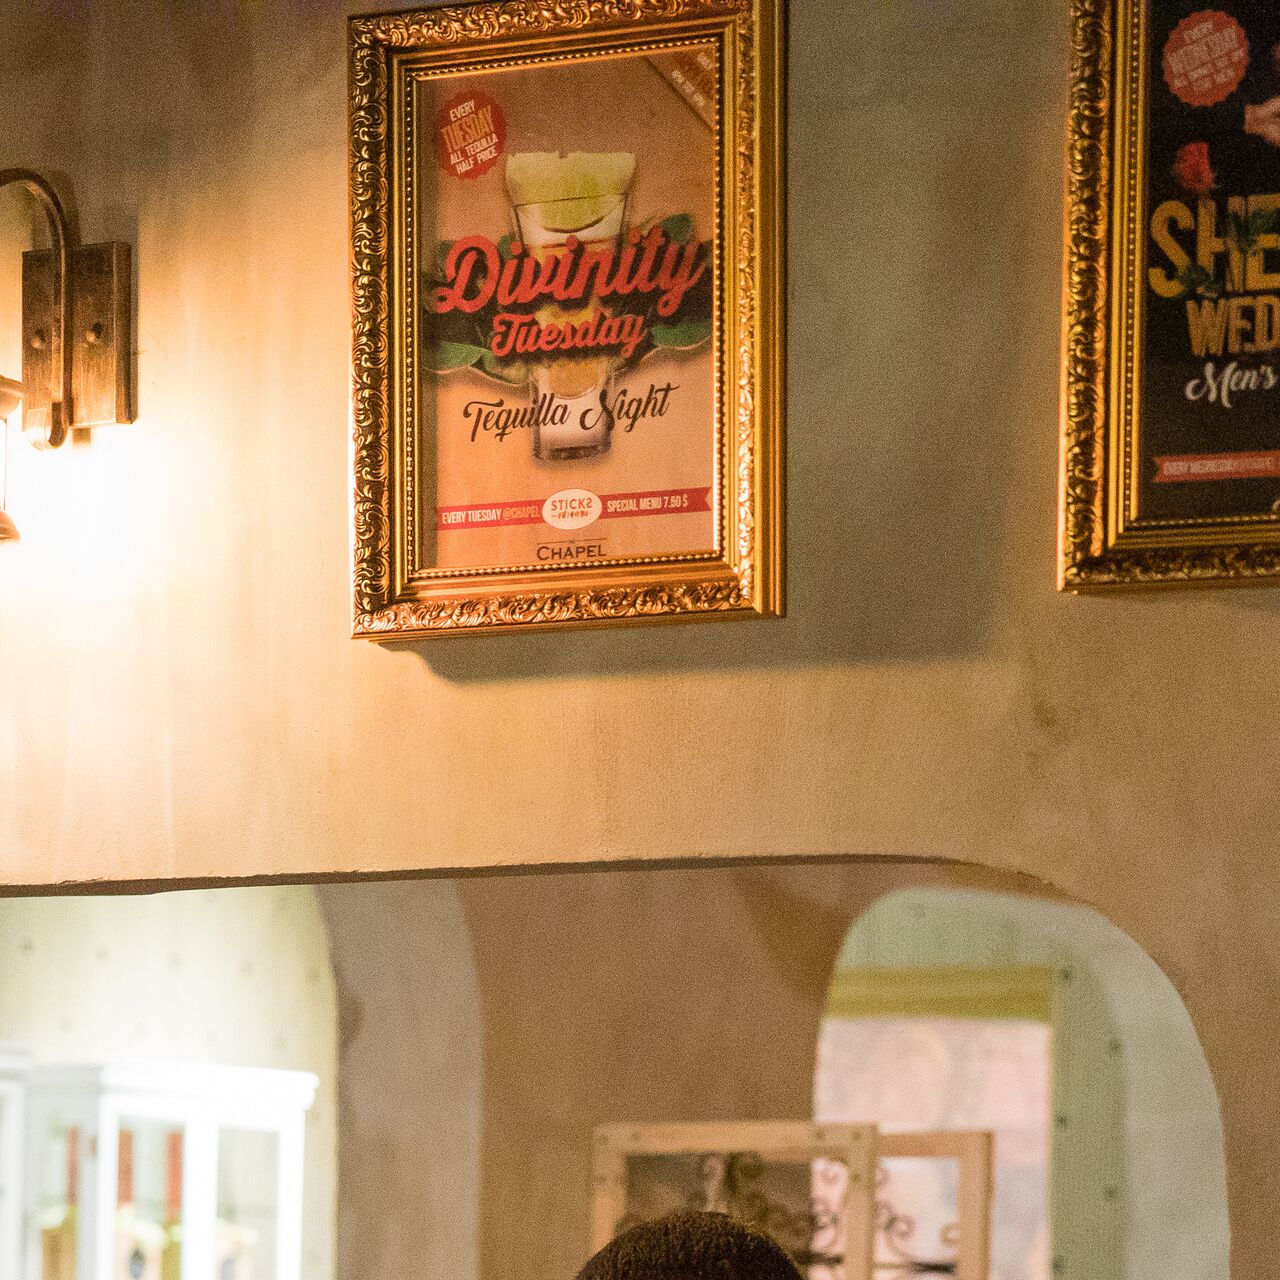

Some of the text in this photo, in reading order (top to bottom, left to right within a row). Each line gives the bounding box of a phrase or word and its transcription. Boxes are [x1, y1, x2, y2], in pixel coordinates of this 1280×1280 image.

[449, 99, 475, 122] EVERY
[440, 105, 495, 154] TUESDAY
[450, 150, 464, 165] ALL
[455, 145, 498, 175] HALF PRICE
[433, 225, 707, 318] Divinity
[490, 307, 648, 359] Tuesday
[1184, 361, 1278, 409] Men's
[462, 381, 681, 443] Tequilla Night
[442, 511, 466, 524] EVERY
[467, 508, 502, 523] TUESDAY
[607, 498, 638, 512] SPECIAL
[639, 496, 662, 510] MENU
[536, 543, 607, 561] CHAPEL
